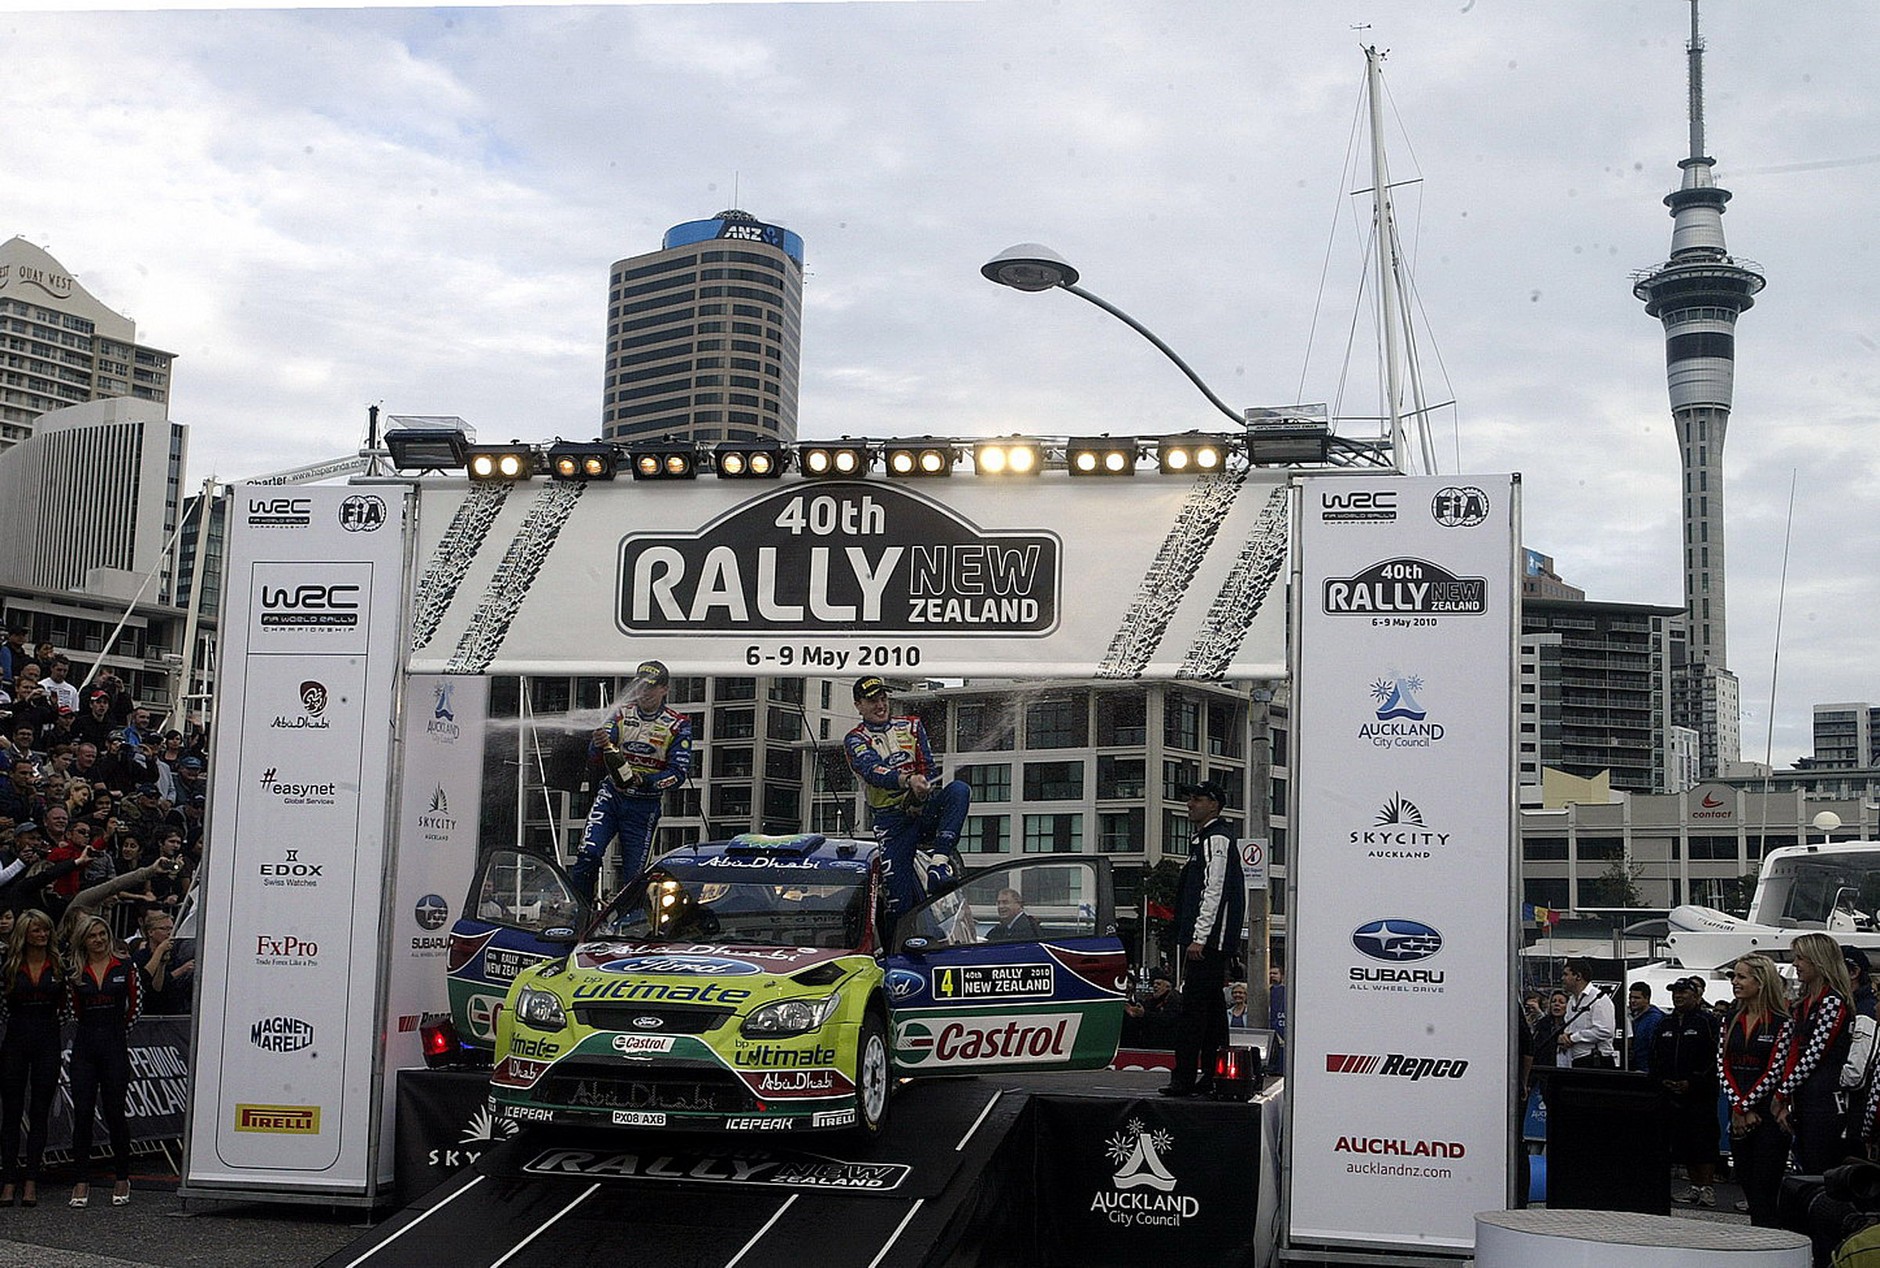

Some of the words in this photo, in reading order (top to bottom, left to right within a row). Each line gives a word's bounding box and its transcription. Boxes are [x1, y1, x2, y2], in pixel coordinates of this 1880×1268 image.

[724, 226, 762, 241] ANZ
[19, 266, 43, 282] QUAY
[49, 273, 72, 290] WEST
[250, 499, 311, 514] WRC
[1322, 492, 1397, 509] WRC
[775, 495, 885, 535] 40th
[1381, 564, 1422, 580] 40th
[632, 546, 903, 622] RALLY
[909, 545, 1040, 596] NEW
[262, 585, 360, 609] WRC
[1329, 582, 1430, 611] RALLY
[1431, 582, 1480, 601] NEW
[908, 598, 1039, 623] ZEALAND
[1431, 601, 1480, 611] ZEALAND
[1393, 618, 1411, 628] May
[1413, 618, 1437, 626] 2010
[802, 647, 850, 670] May
[858, 646, 921, 667] 2010
[427, 720, 460, 740] AUCKLAND
[1358, 723, 1445, 741] AUCKLAND
[1373, 737, 1393, 749] City
[1395, 737, 1430, 748] Council
[418, 815, 457, 830] SKYCITY
[1693, 810, 1732, 819] contact
[1350, 831, 1450, 846] SKYCITY
[1368, 850, 1431, 858] AUCKLAND
[260, 864, 323, 876] EDOX
[264, 878, 285, 887] Swiss
[287, 878, 317, 887] Watches
[256, 935, 318, 957] FxPro
[411, 937, 448, 949] SUBARU
[624, 958, 735, 974] Ford
[965, 971, 982, 980] 40th
[992, 968, 1023, 980] RALLY
[1031, 968, 1050, 977] 2010
[941, 969, 953, 997] 4
[1349, 967, 1445, 984] SUBARU
[573, 980, 751, 1003] ultimate
[965, 981, 992, 994] NEW
[995, 978, 1050, 992] ZEALAND
[625, 1038, 666, 1050] Castrol
[735, 1039, 749, 1049] bp
[935, 1019, 1066, 1061] Castrol
[127, 1046, 188, 1078] PENING
[735, 1044, 835, 1067] ultimate
[1379, 1054, 1469, 1081] Repco
[242, 1109, 312, 1129] PIRELLI
[504, 1106, 554, 1121] ICEPEAK
[614, 1112, 639, 1123] PX08
[642, 1113, 664, 1124] AXB
[812, 1108, 856, 1127] PIRELLI
[726, 1118, 793, 1130] ICEPEAK
[1334, 1136, 1465, 1159] AUCKLAND
[536, 1151, 780, 1180] RALLY
[776, 1162, 895, 1179] NEW
[1346, 1161, 1452, 1179] aucklandnz.com
[769, 1175, 884, 1187] ZEALAND
[1091, 1191, 1200, 1218] AUCKLAND
[1109, 1210, 1133, 1227] City
[1136, 1212, 1180, 1227] Council
